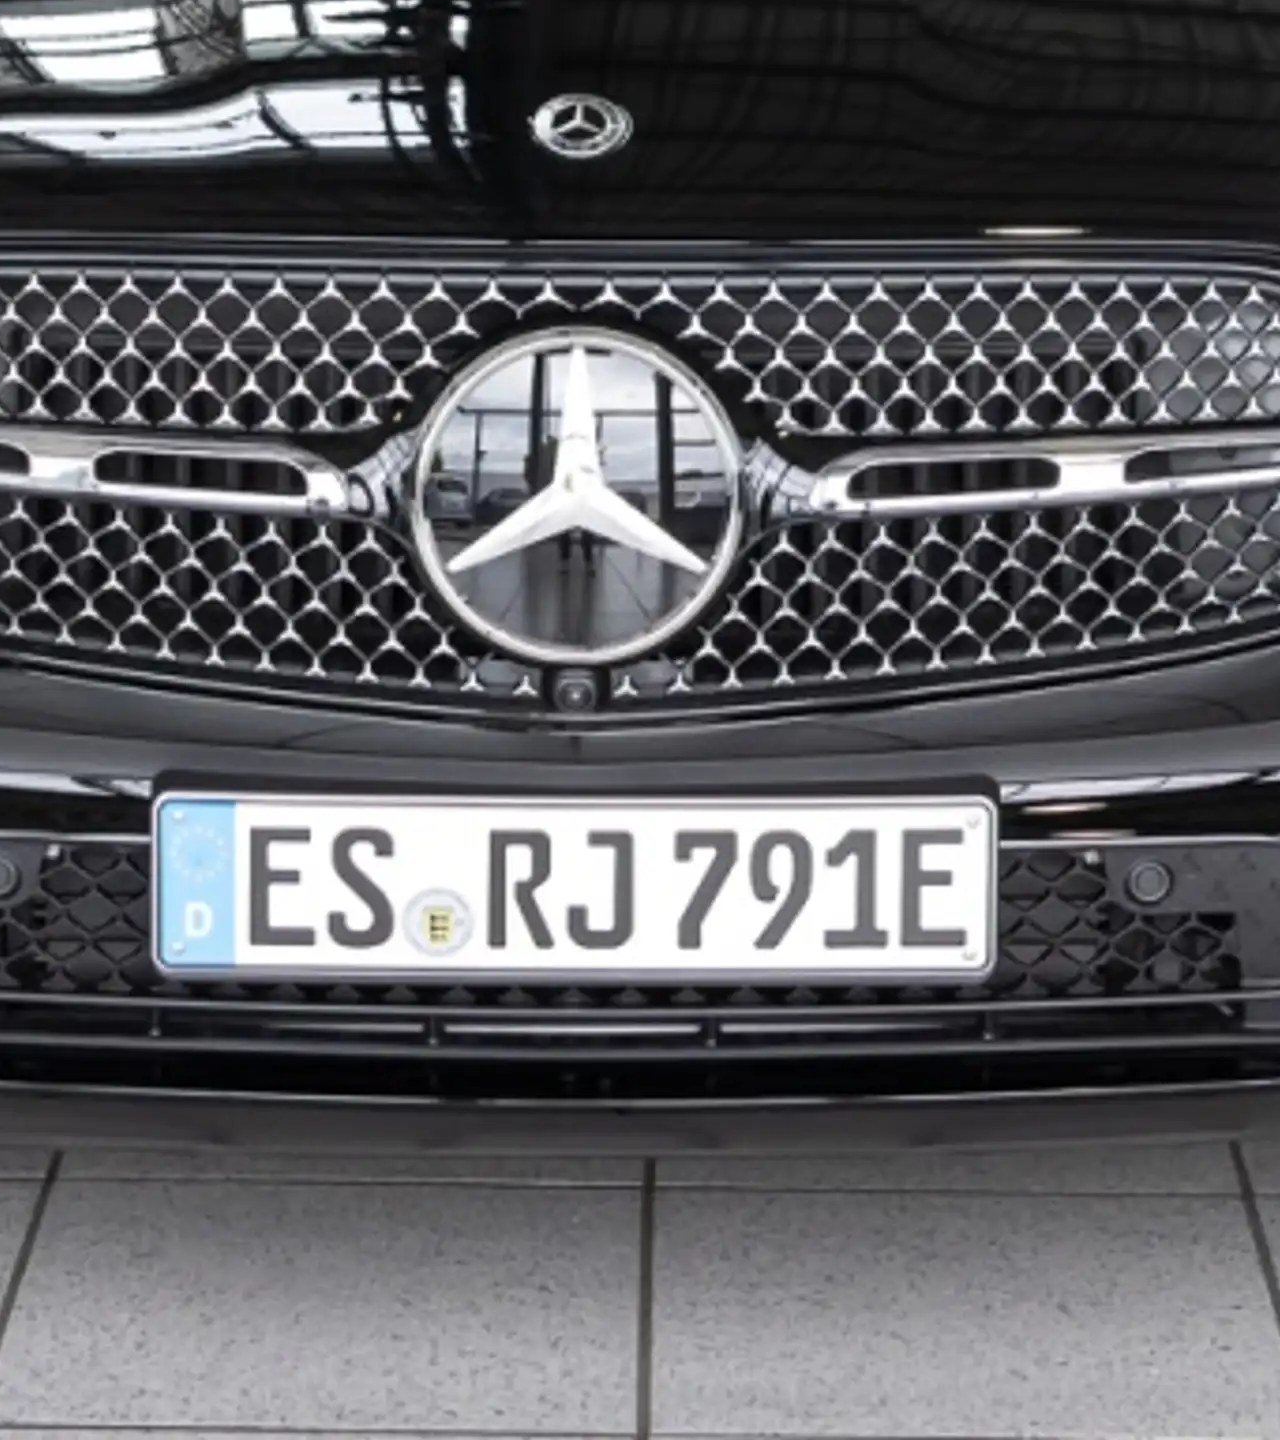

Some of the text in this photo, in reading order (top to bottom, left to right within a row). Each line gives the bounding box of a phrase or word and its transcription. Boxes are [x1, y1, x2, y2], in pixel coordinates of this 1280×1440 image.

[183, 902, 214, 939] D
[249, 826, 968, 950] ES RJ 791E
